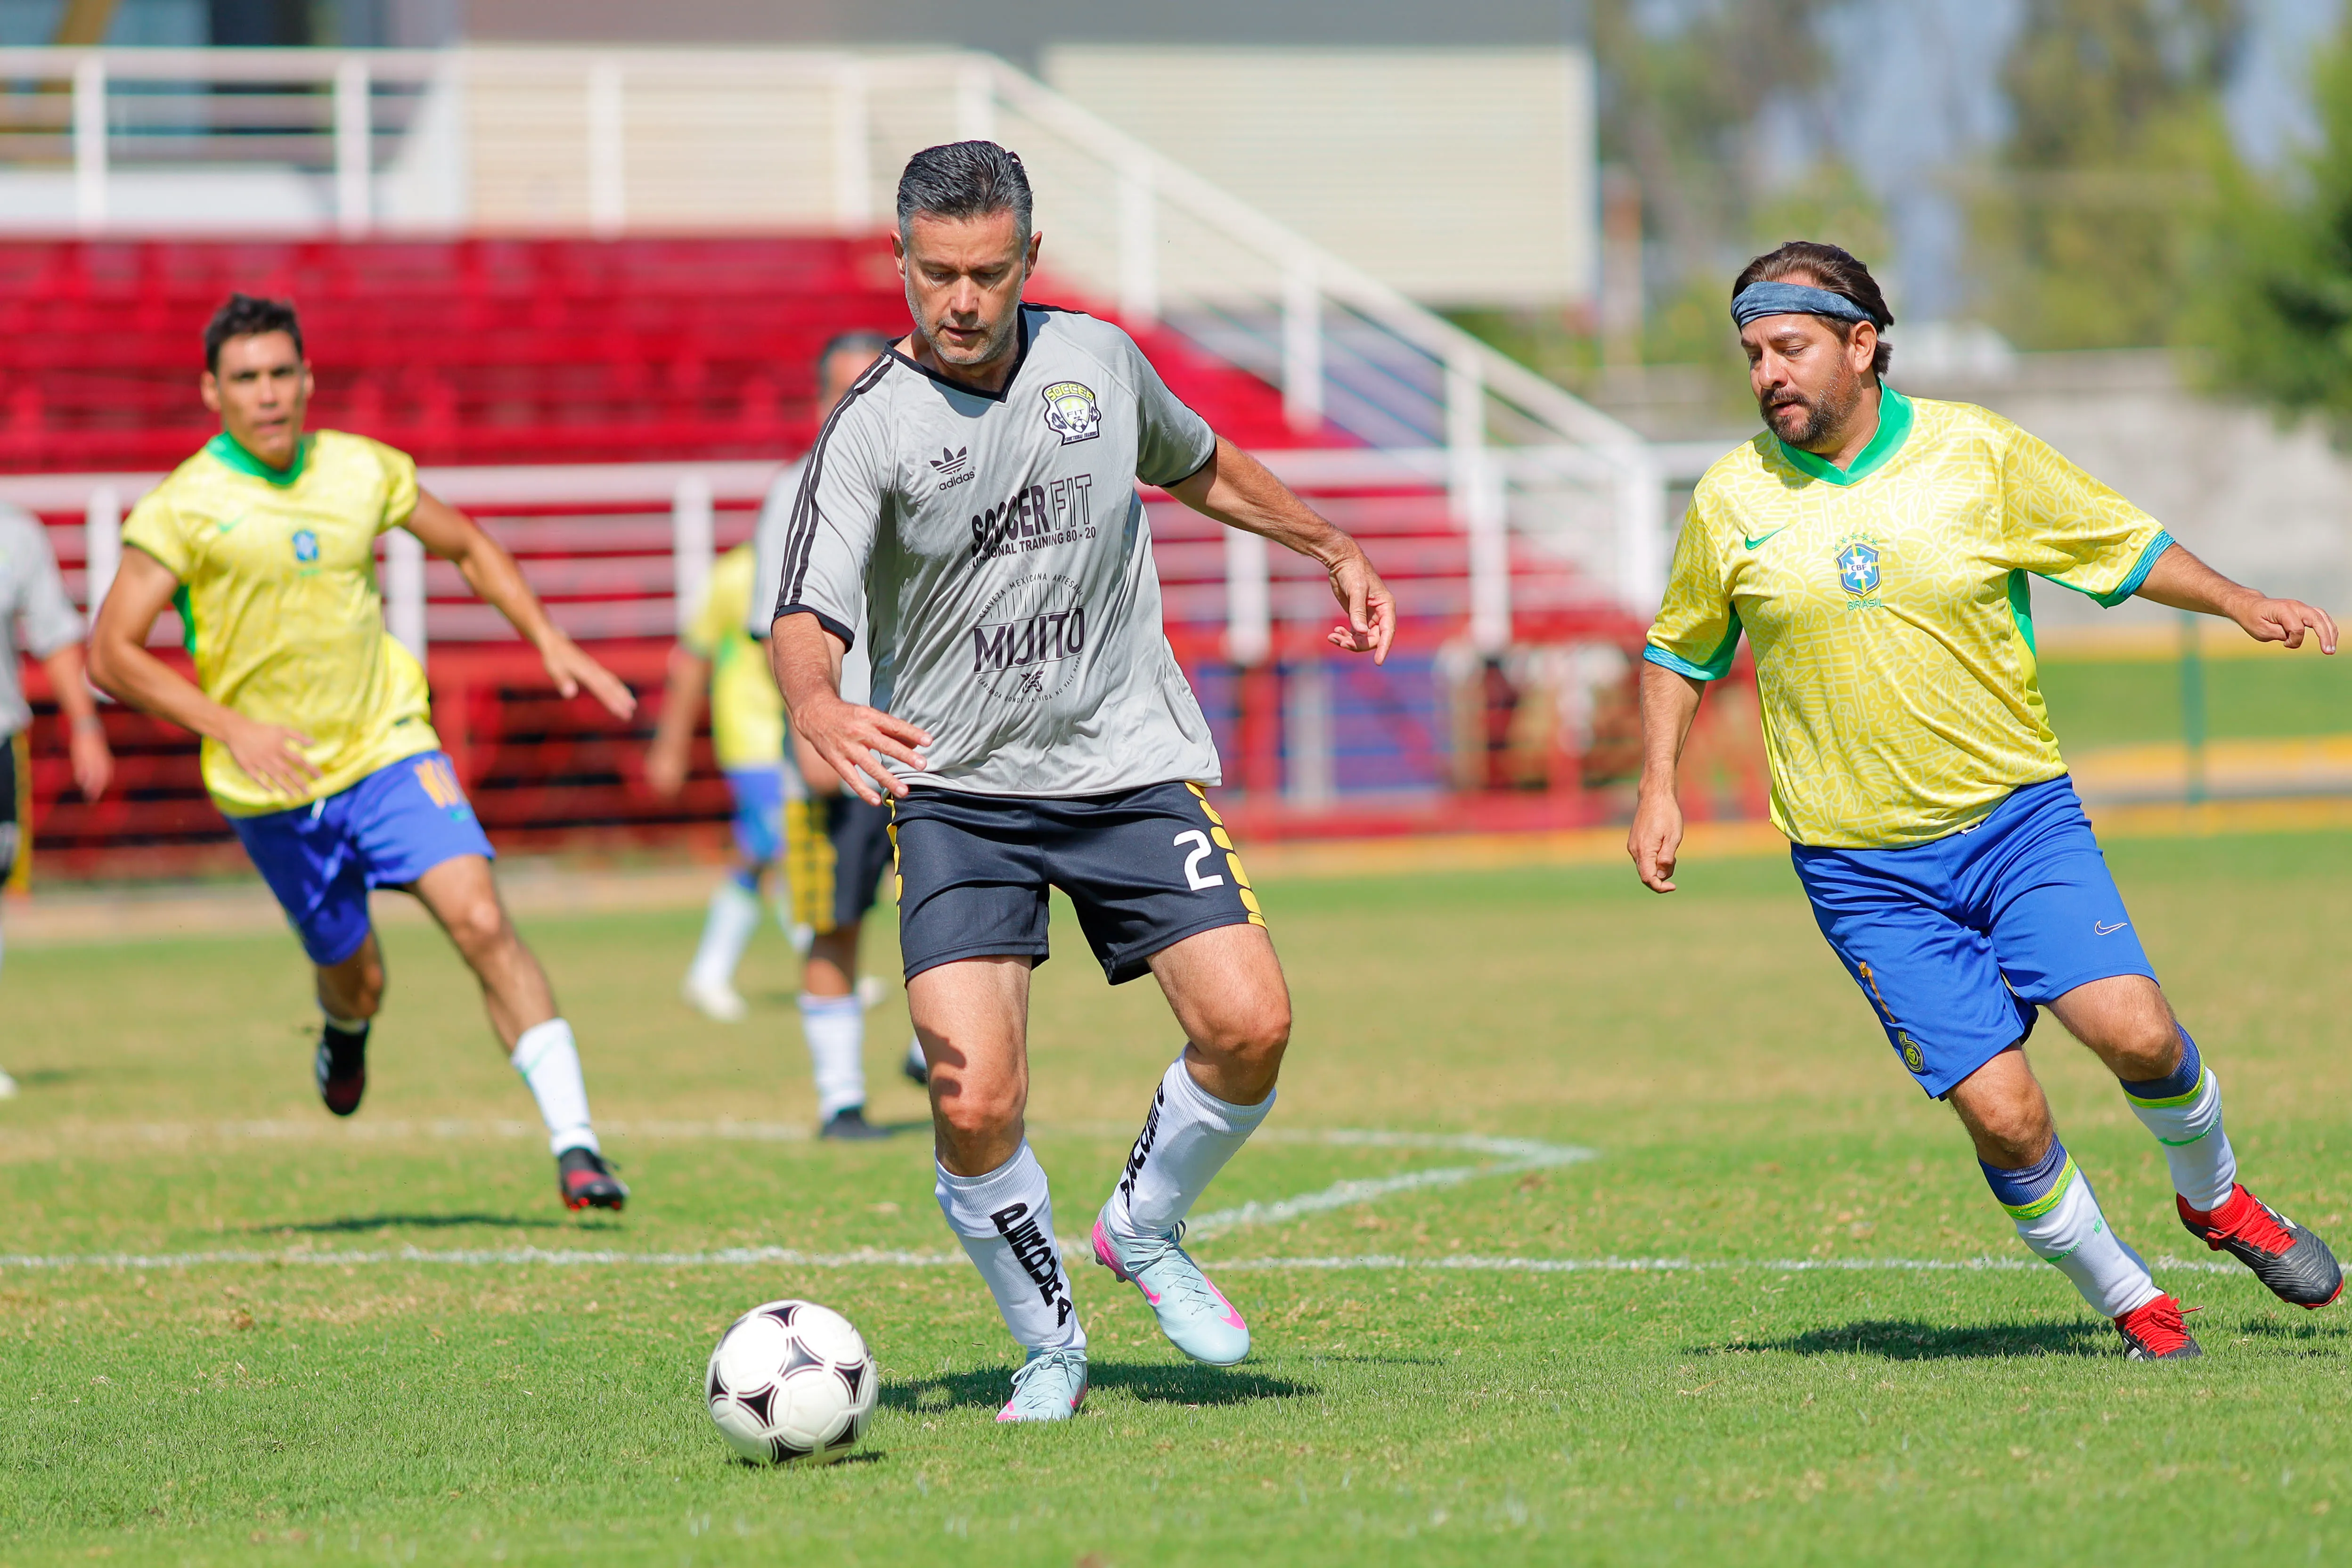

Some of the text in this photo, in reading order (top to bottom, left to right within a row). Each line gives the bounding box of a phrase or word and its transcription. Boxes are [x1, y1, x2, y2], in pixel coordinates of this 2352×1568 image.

[1045, 383, 1094, 402] SOCCER
[1067, 408, 1084, 417] FIT
[939, 471, 975, 490] adidas
[972, 474, 1092, 557] SOCCER FIT
[1019, 532, 1064, 553] TRAINING
[1066, 530, 1077, 542] 80
[1085, 526, 1096, 539] 20
[979, 589, 1006, 618] CERVEZA
[1009, 573, 1047, 589] MEXICANA
[1846, 598, 1885, 611] BRASIL
[974, 608, 1084, 672] MIJITO
[977, 675, 1002, 698] ELABORADA
[1055, 688, 1063, 696] NO
[1063, 674, 1074, 687] VALE
[1073, 657, 1081, 672] NADA
[1173, 829, 1224, 891] 2
